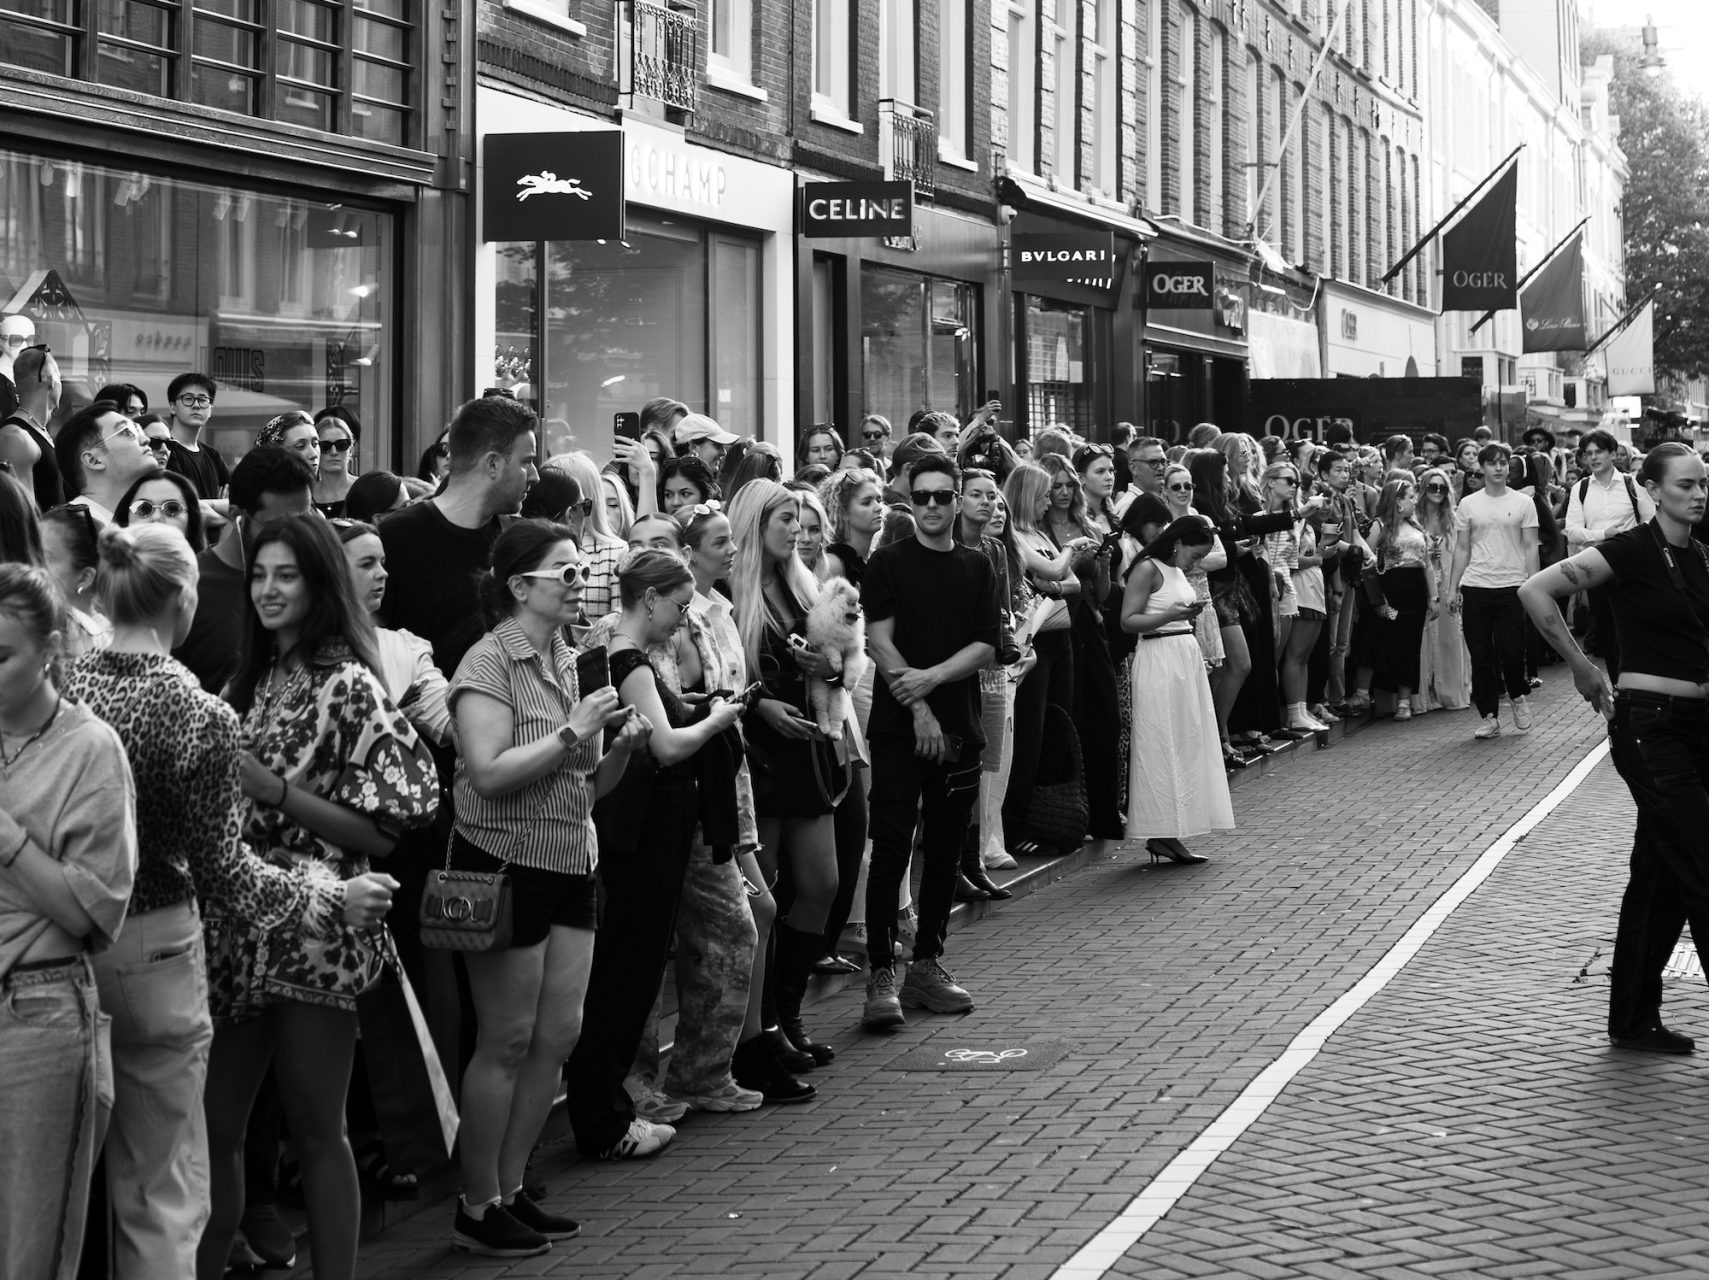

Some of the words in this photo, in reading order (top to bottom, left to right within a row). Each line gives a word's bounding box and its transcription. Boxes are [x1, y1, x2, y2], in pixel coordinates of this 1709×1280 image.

[628, 142, 727, 205] GCHAMP
[808, 198, 906, 220] CELINE
[1021, 249, 1105, 262] BVLGARI
[1152, 273, 1209, 296] OGER
[1453, 270, 1508, 289] OGER
